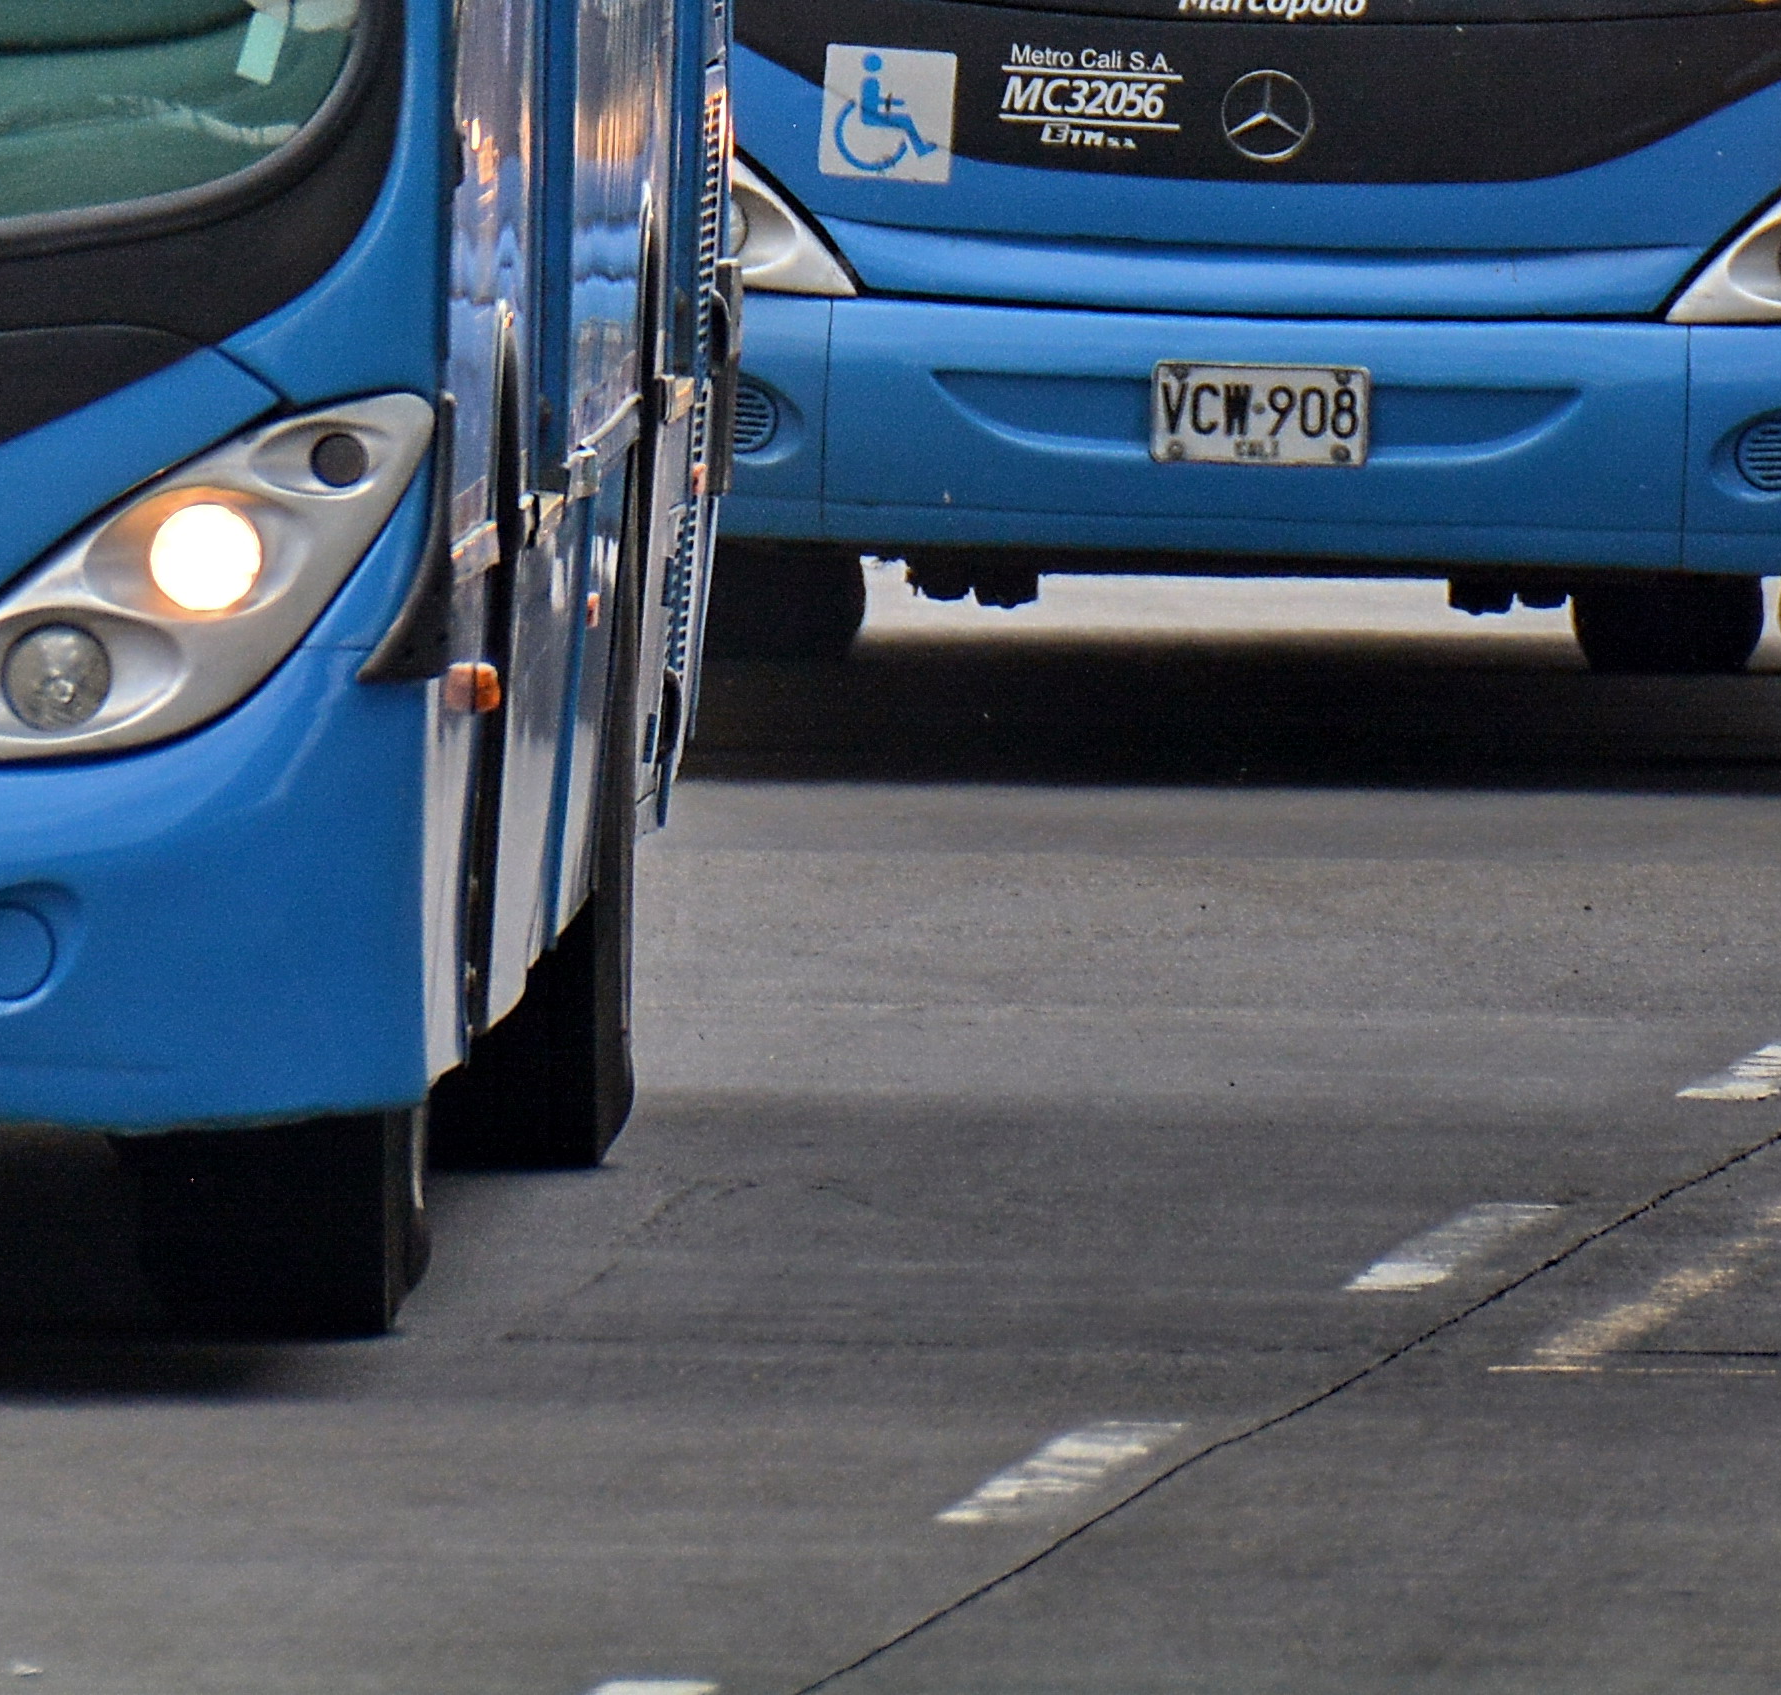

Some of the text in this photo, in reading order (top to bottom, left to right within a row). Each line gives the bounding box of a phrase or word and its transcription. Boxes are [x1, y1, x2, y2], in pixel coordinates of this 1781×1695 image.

[1010, 43, 1175, 73] Metro Cali S.A.
[1000, 75, 1168, 119] MC32056
